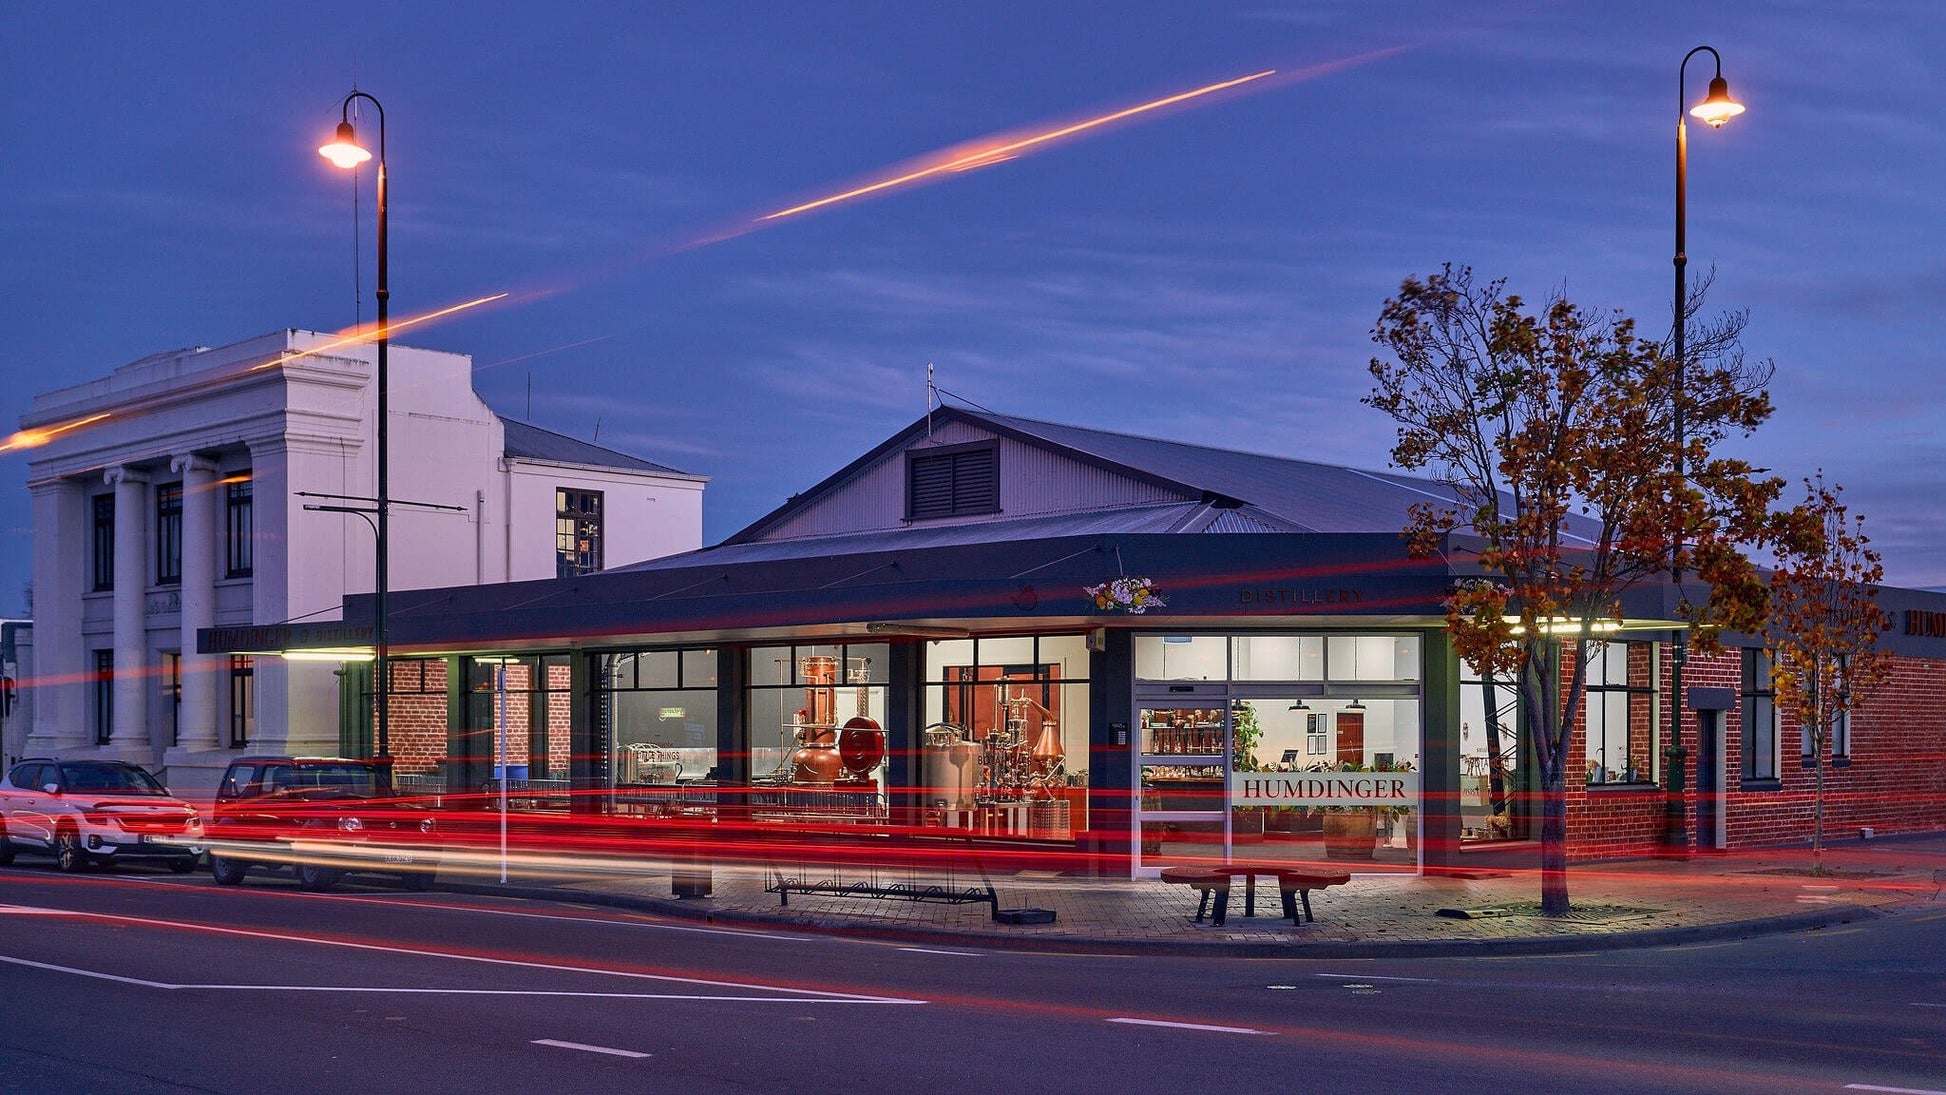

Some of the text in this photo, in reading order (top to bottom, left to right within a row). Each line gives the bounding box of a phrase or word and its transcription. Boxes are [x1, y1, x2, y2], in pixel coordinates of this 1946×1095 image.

[1240, 588, 1364, 604] DISTILLERY
[207, 625, 374, 650] HUMDINGER DISTILLERY
[656, 750, 680, 761] THINGS
[1243, 779, 1407, 799] HUMDINGER
